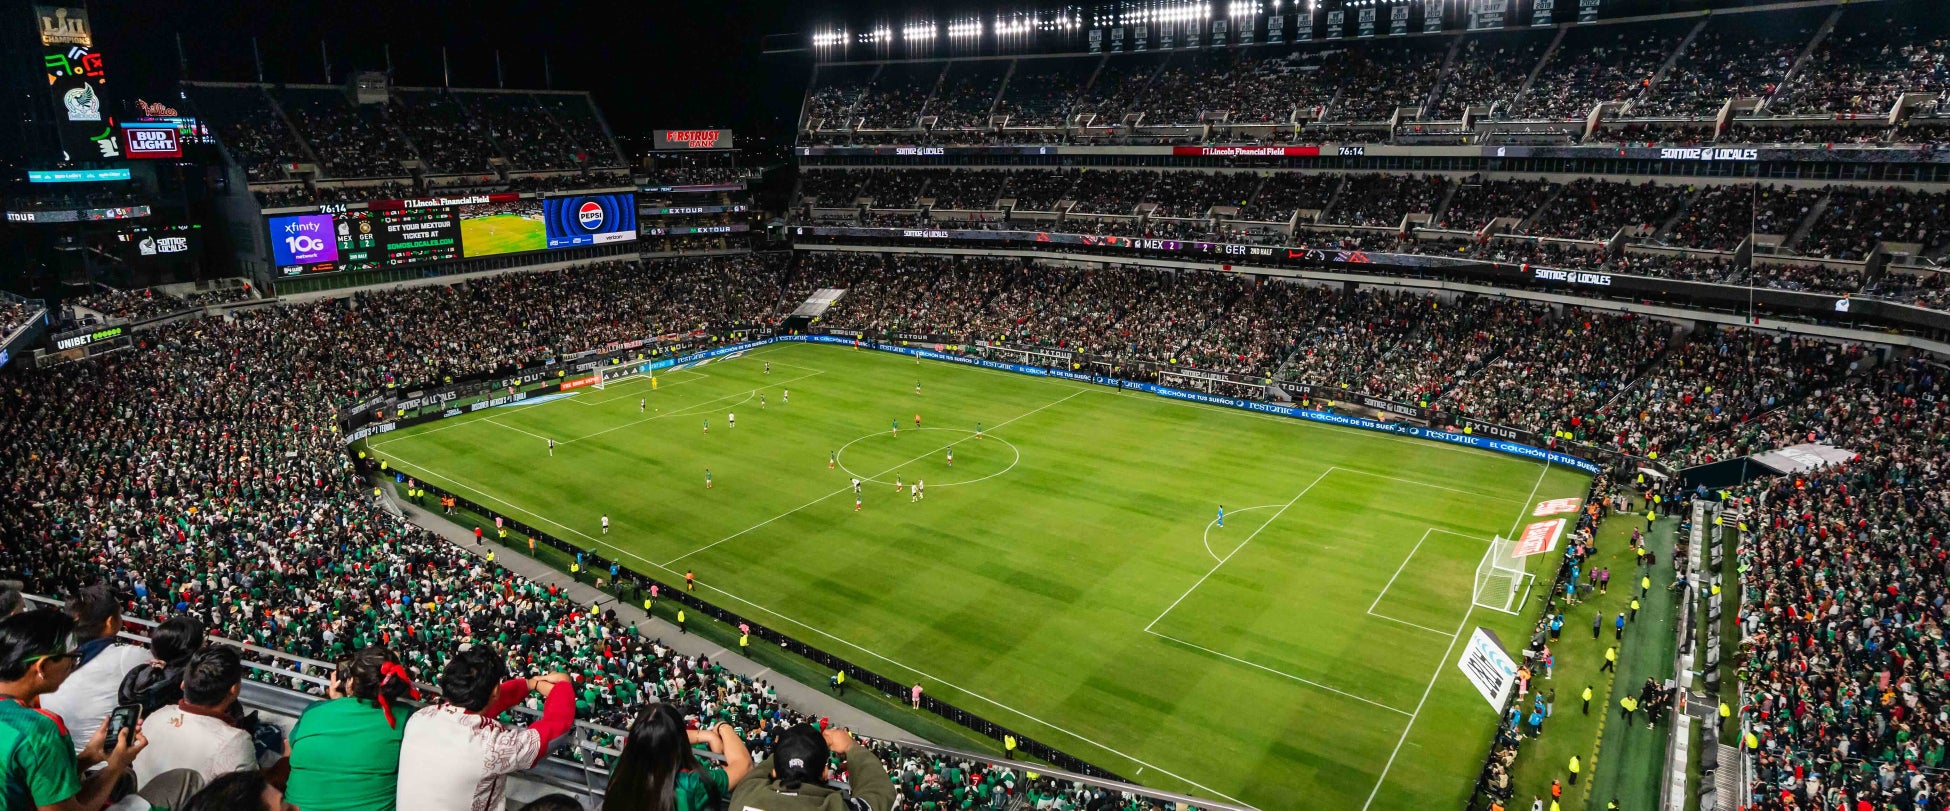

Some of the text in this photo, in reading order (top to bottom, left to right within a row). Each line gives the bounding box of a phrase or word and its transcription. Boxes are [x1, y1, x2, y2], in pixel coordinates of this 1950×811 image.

[42, 35, 92, 46] CHAMPIONS
[136, 131, 167, 141] BUD
[689, 140, 715, 148] BANK
[1209, 147, 1285, 156] Lincoln Financial Field
[1338, 147, 1364, 156] 76:14
[1714, 148, 1758, 161] LOCALES
[440, 196, 472, 207] Financial
[472, 195, 490, 204] Field
[319, 203, 347, 214] 76:14
[580, 212, 602, 220] PEPSI
[284, 221, 321, 234] xfinity
[401, 222, 420, 231] YOUR
[337, 234, 353, 242] MEX
[359, 233, 374, 241] GER
[402, 230, 439, 240] TICKETS AT
[284, 235, 324, 254] 10G
[1144, 239, 1163, 249] MEX
[1202, 244, 1208, 252] 2
[1225, 245, 1246, 255] GER
[1250, 247, 1273, 256] 2ND HALF
[1577, 272, 1612, 286] LOCALES
[57, 333, 92, 350] UNIBET
[1107, 377, 1144, 390] resonic
[1310, 413, 1349, 424] COLCHÓN
[1489, 441, 1499, 449] EL
[1500, 443, 1546, 458] COLCHÓN
[1548, 453, 1559, 462] DE
[1561, 456, 1576, 466] TUS
